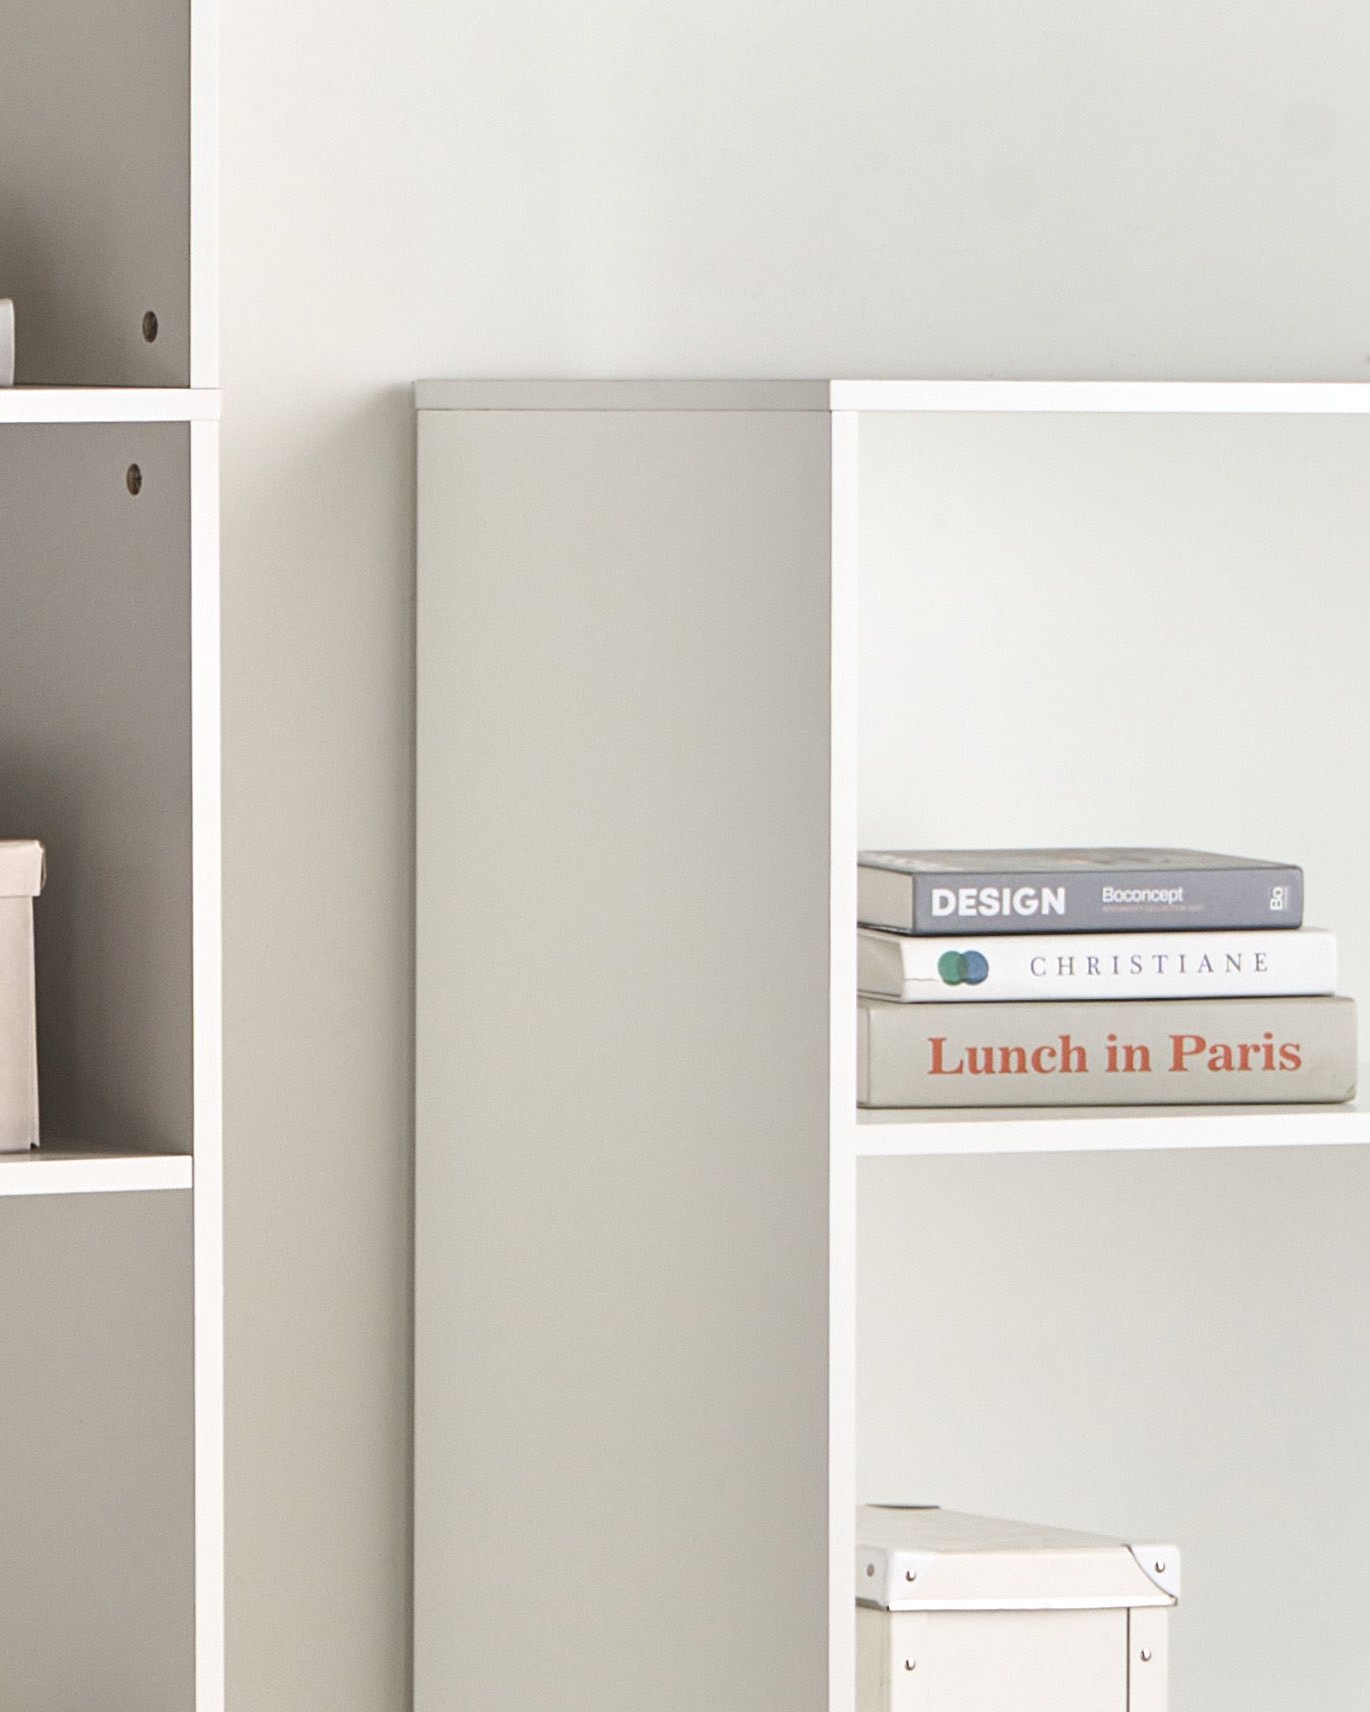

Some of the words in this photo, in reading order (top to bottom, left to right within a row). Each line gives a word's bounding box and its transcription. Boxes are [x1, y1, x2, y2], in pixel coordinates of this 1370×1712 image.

[931, 888, 1066, 917] DESIGN
[1102, 886, 1184, 905] Boconcept
[1270, 886, 1283, 910] Bo
[1030, 952, 1269, 977] CHRISTIANE
[927, 1034, 1088, 1075] Lunch
[1106, 1033, 1152, 1074] in
[1169, 1032, 1302, 1073] Paris
